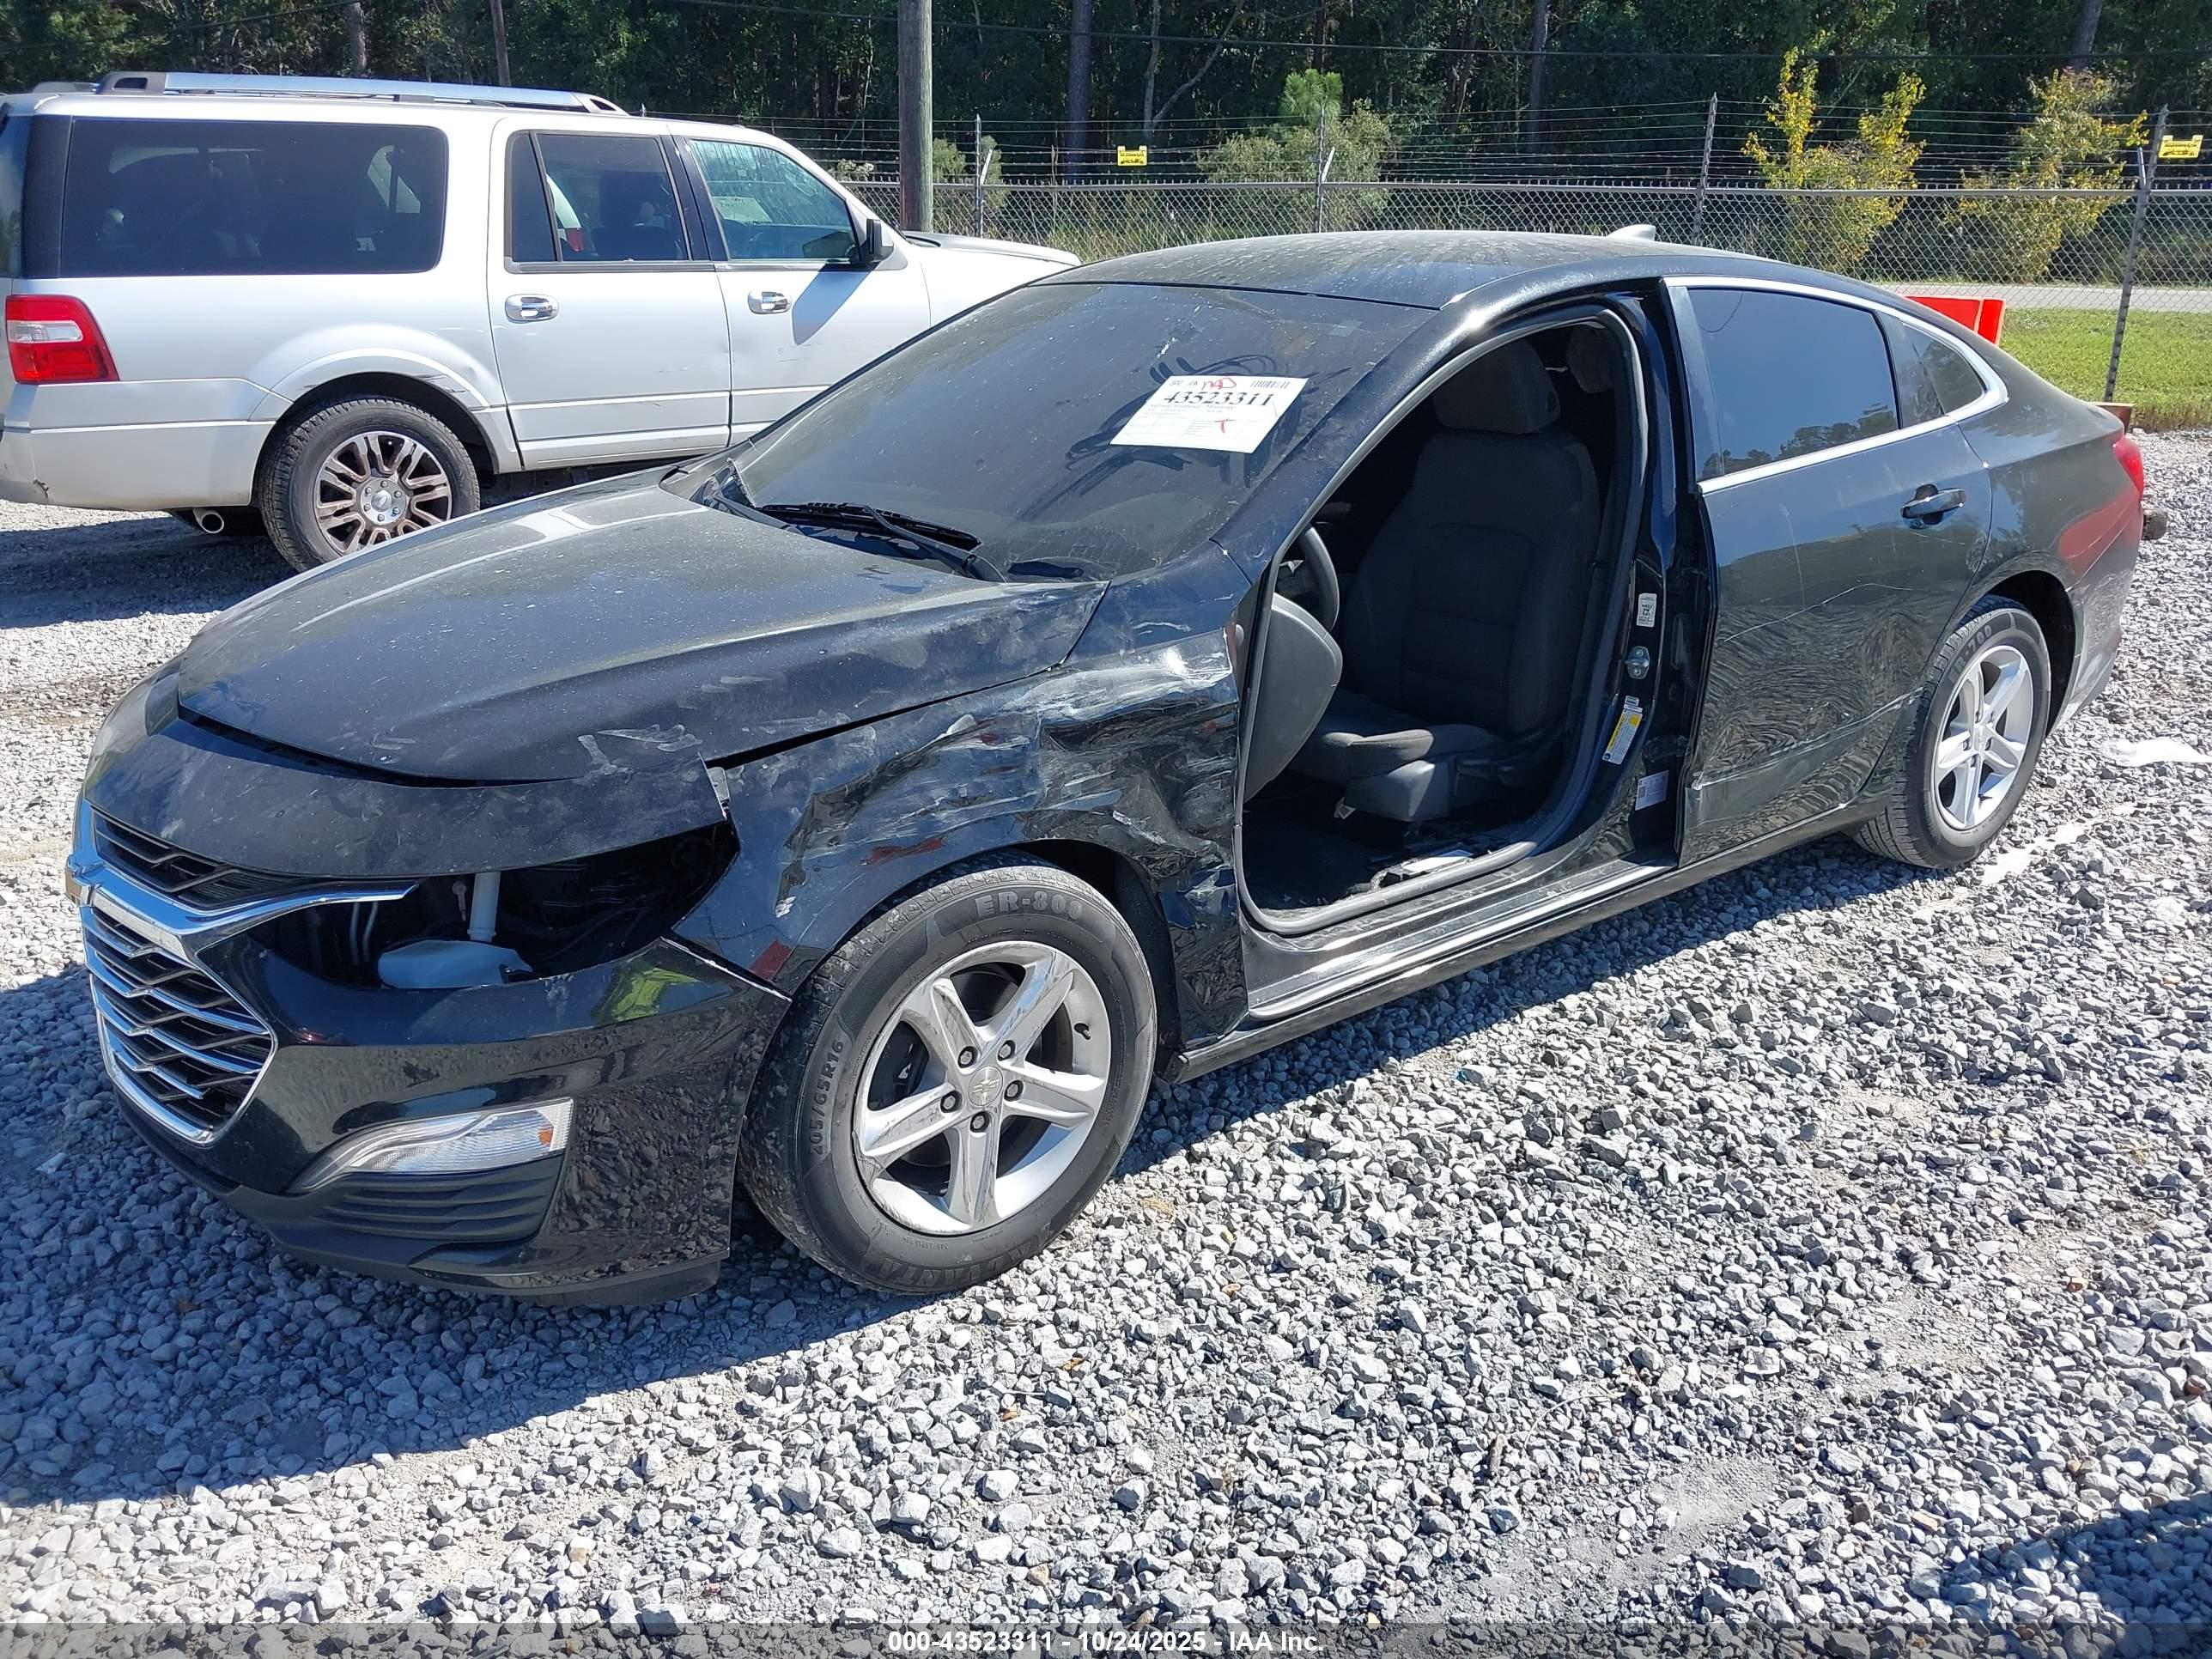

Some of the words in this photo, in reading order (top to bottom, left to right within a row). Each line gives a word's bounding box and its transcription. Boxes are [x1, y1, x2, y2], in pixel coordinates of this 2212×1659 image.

[1164, 391, 1274, 406] 43523311
[975, 890, 1083, 921] ER-800
[809, 1040, 842, 1155] 205/65R16
